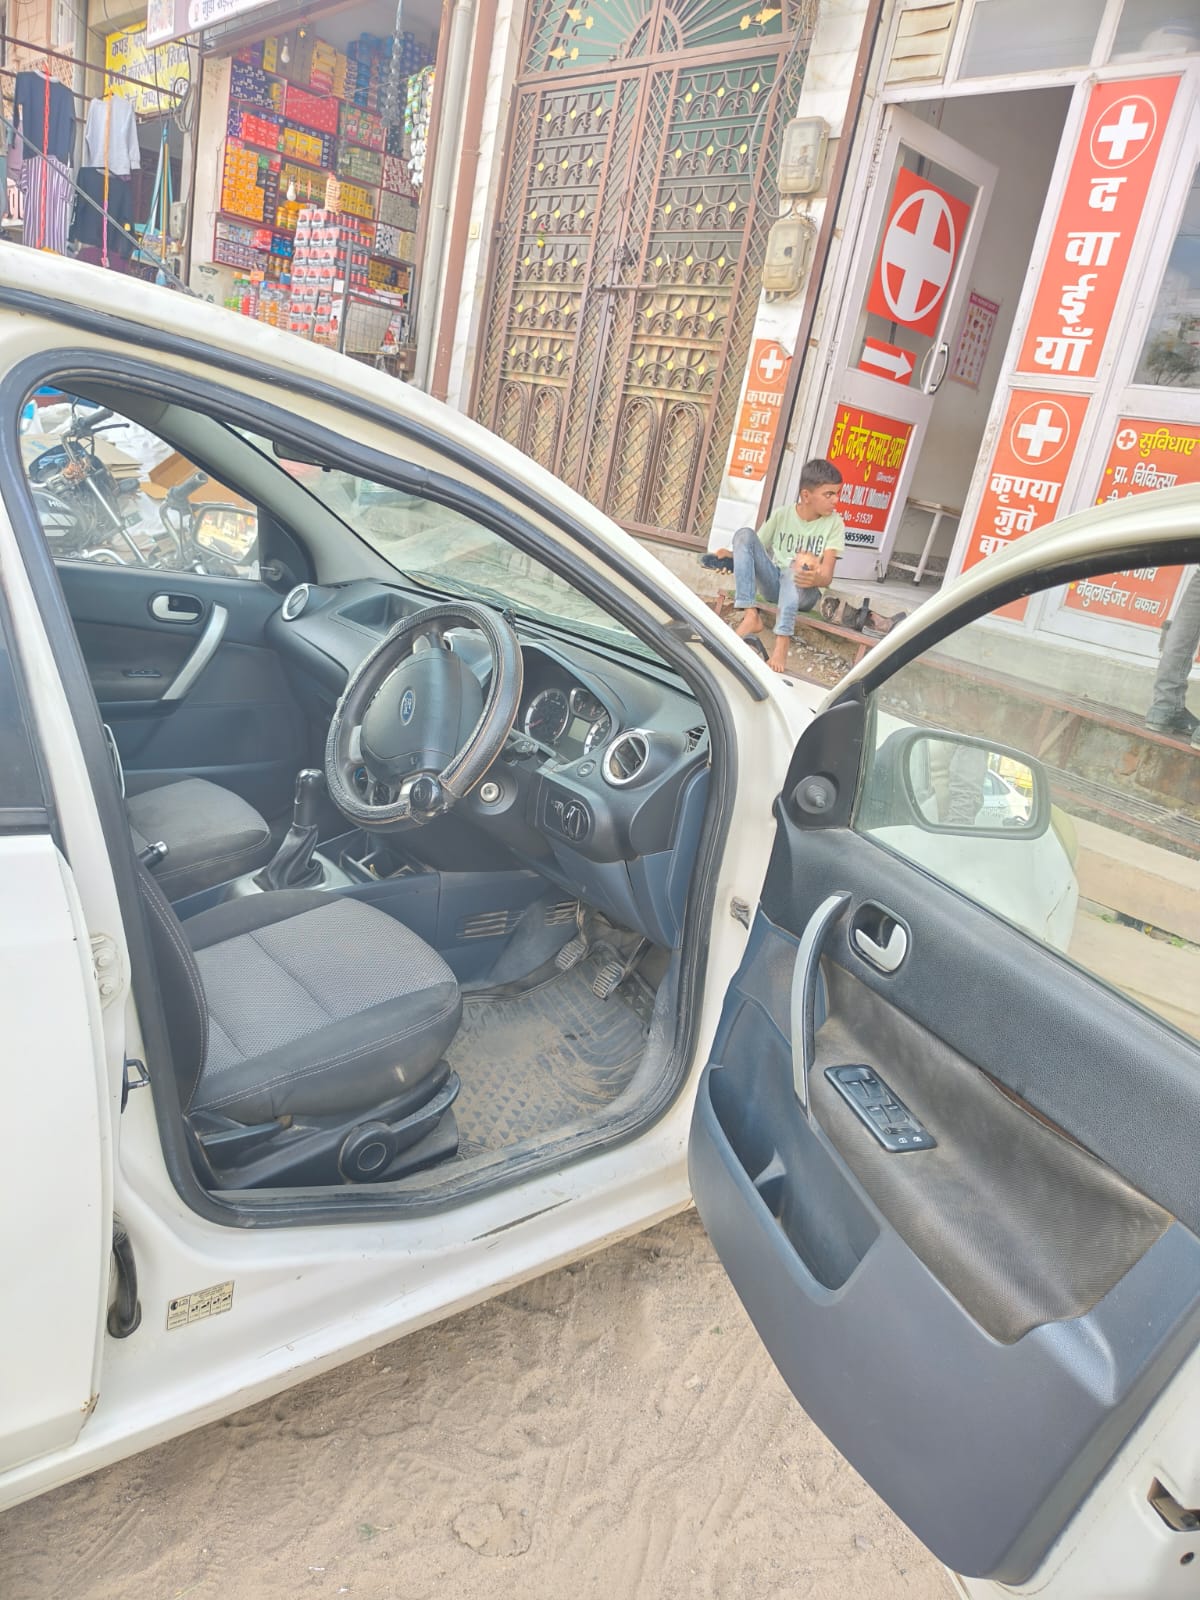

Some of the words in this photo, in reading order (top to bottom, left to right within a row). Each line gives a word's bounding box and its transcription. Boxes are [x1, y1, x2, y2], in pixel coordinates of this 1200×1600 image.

[989, 473, 1061, 504] कृपया
[993, 504, 1038, 535] जुते
[778, 531, 824, 556] YOUNG
